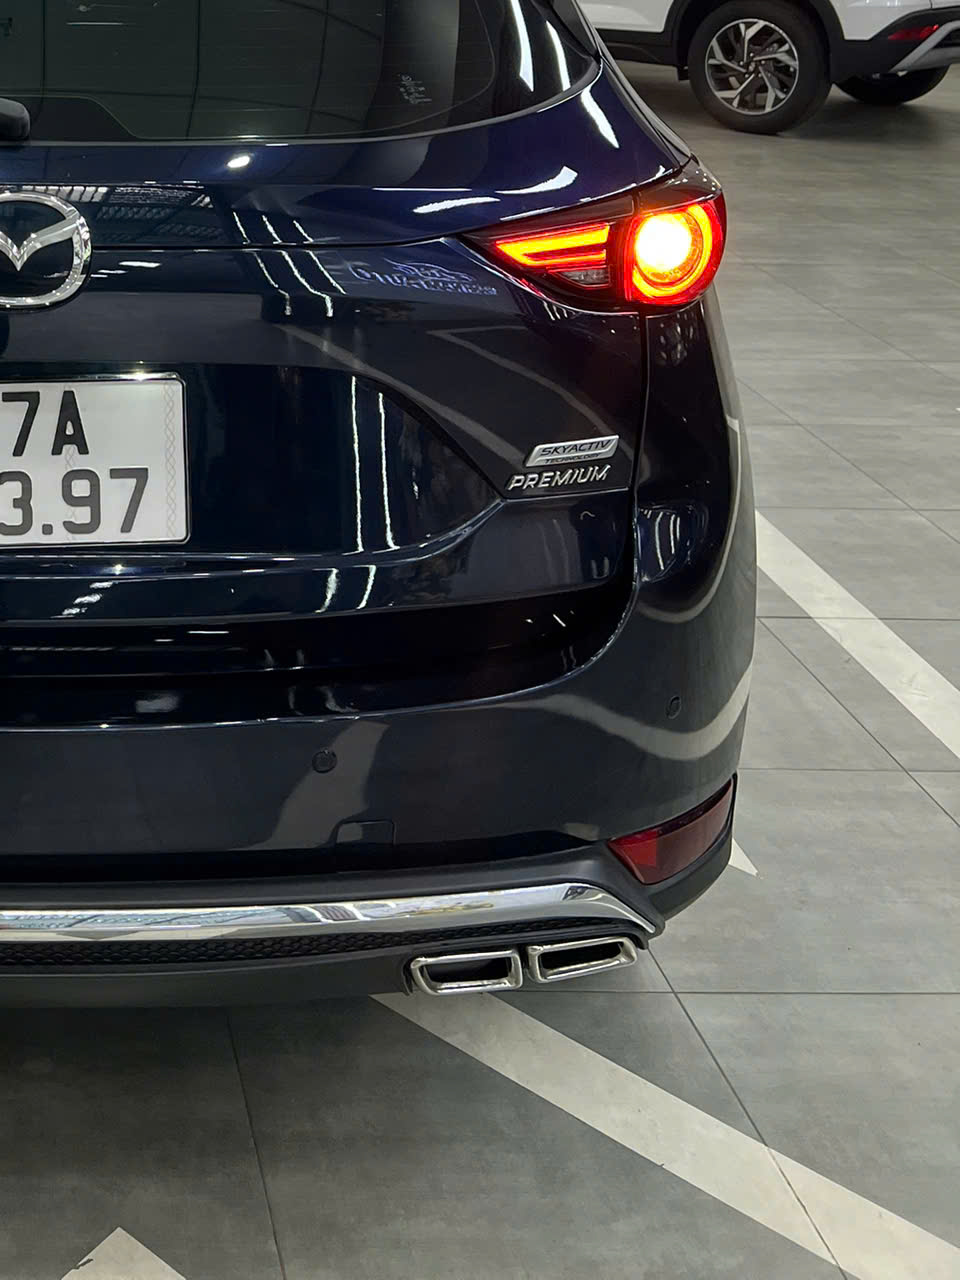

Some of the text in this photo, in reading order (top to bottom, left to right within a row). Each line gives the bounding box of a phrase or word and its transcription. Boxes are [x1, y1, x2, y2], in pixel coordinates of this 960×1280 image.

[541, 440, 610, 456] SKYACTIV
[544, 453, 601, 464] TECHNOLOGY
[507, 464, 611, 490] PREMIUM
